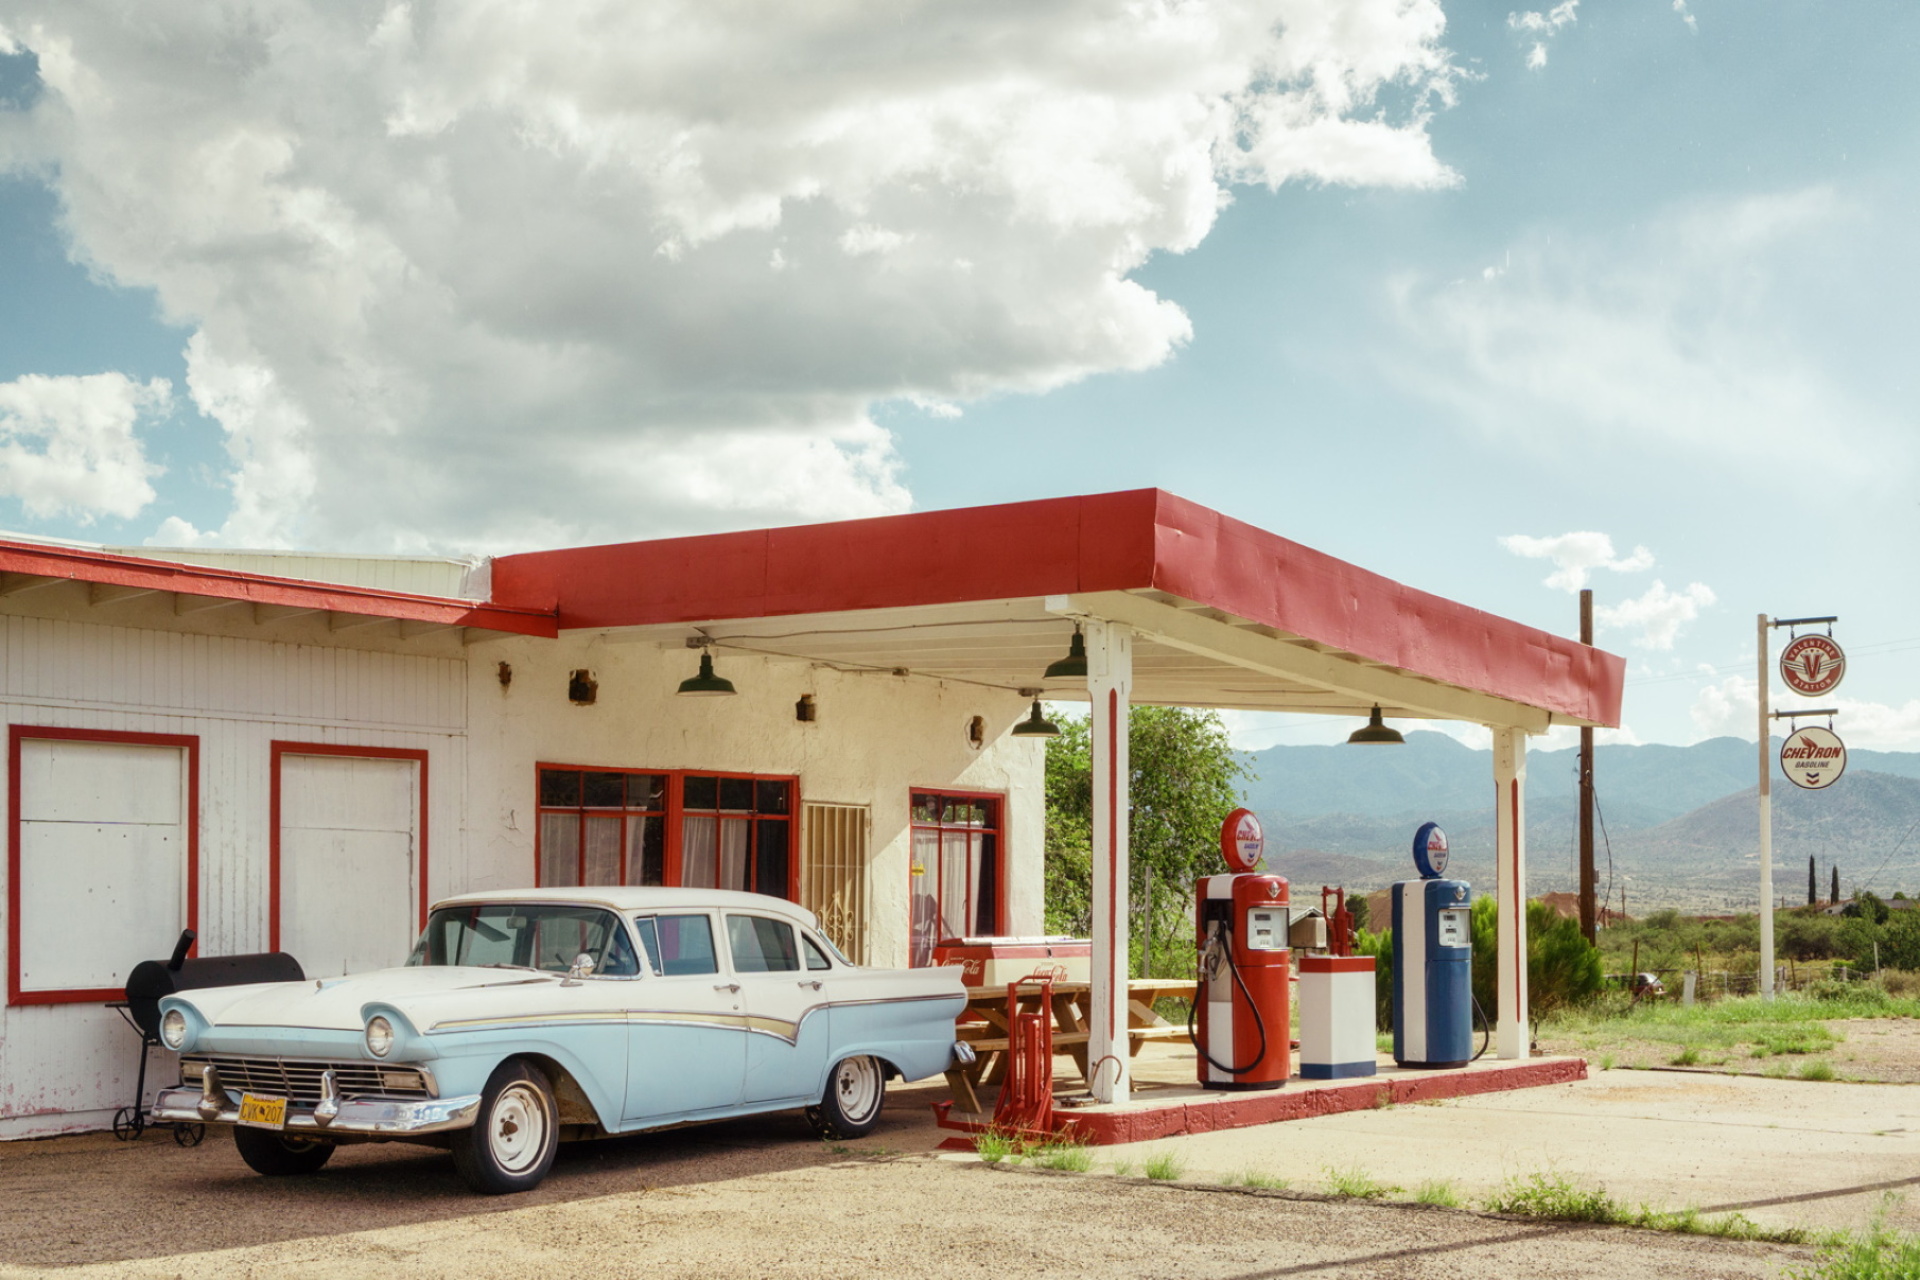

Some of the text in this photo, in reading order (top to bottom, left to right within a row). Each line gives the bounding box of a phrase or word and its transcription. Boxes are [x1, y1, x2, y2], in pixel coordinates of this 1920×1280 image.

[1789, 640, 1835, 658] VALENTINE
[1793, 678, 1832, 690] STATION
[1782, 745, 1842, 759] CHEVRON
[1795, 760, 1830, 769] GASOLINE
[265, 1104, 283, 1122] 207
